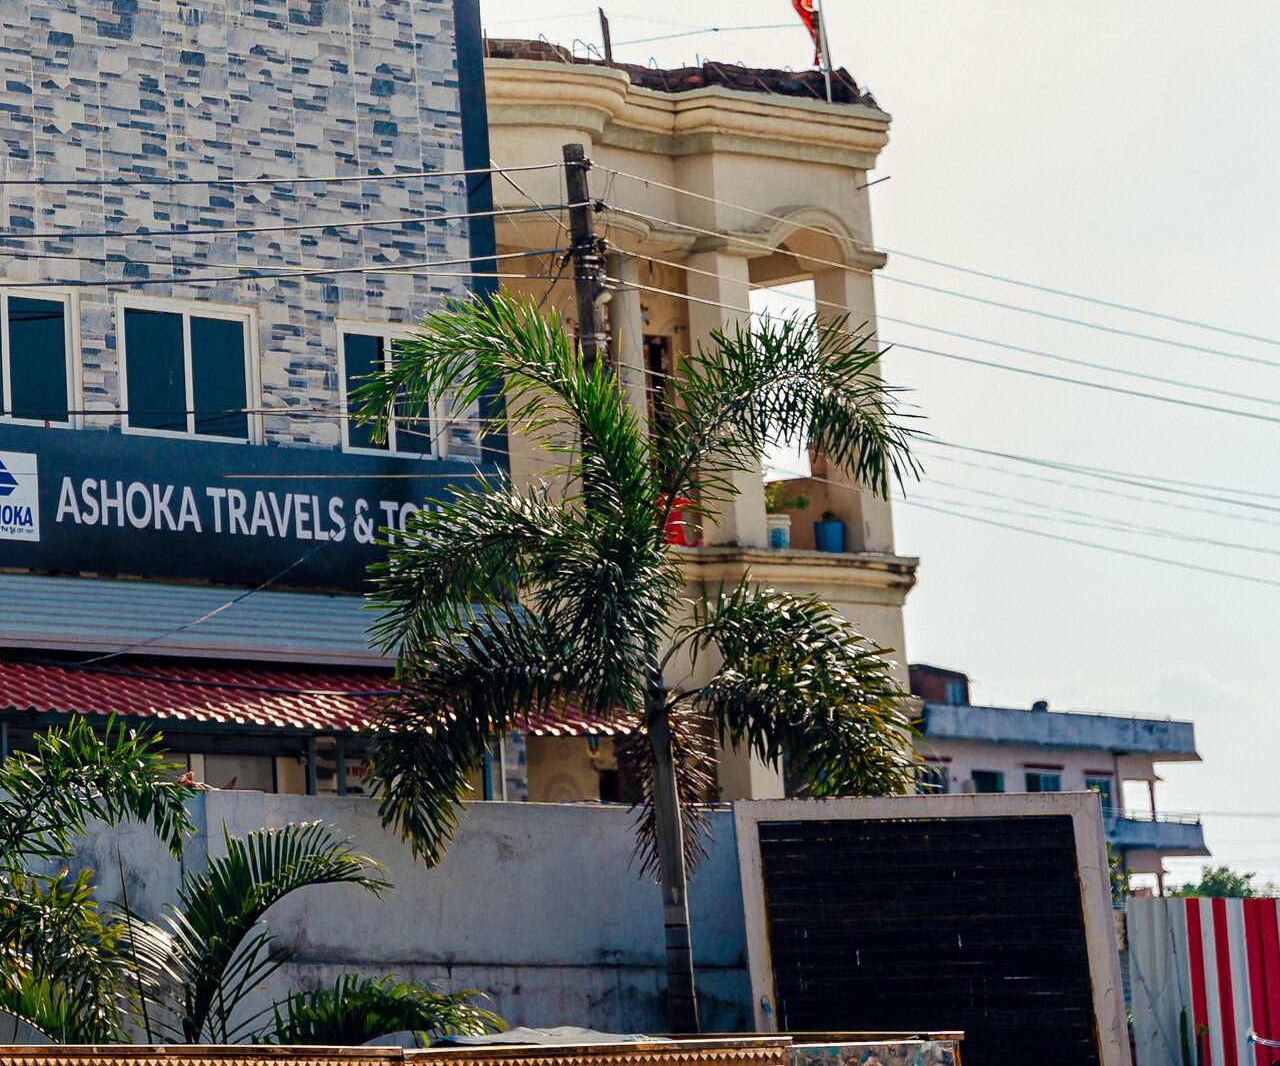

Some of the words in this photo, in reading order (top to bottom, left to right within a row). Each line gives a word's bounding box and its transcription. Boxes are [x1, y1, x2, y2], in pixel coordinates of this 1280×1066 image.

[56, 476, 202, 533] ASHOKA
[206, 487, 346, 543] TRAVELS
[353, 498, 374, 545] &
